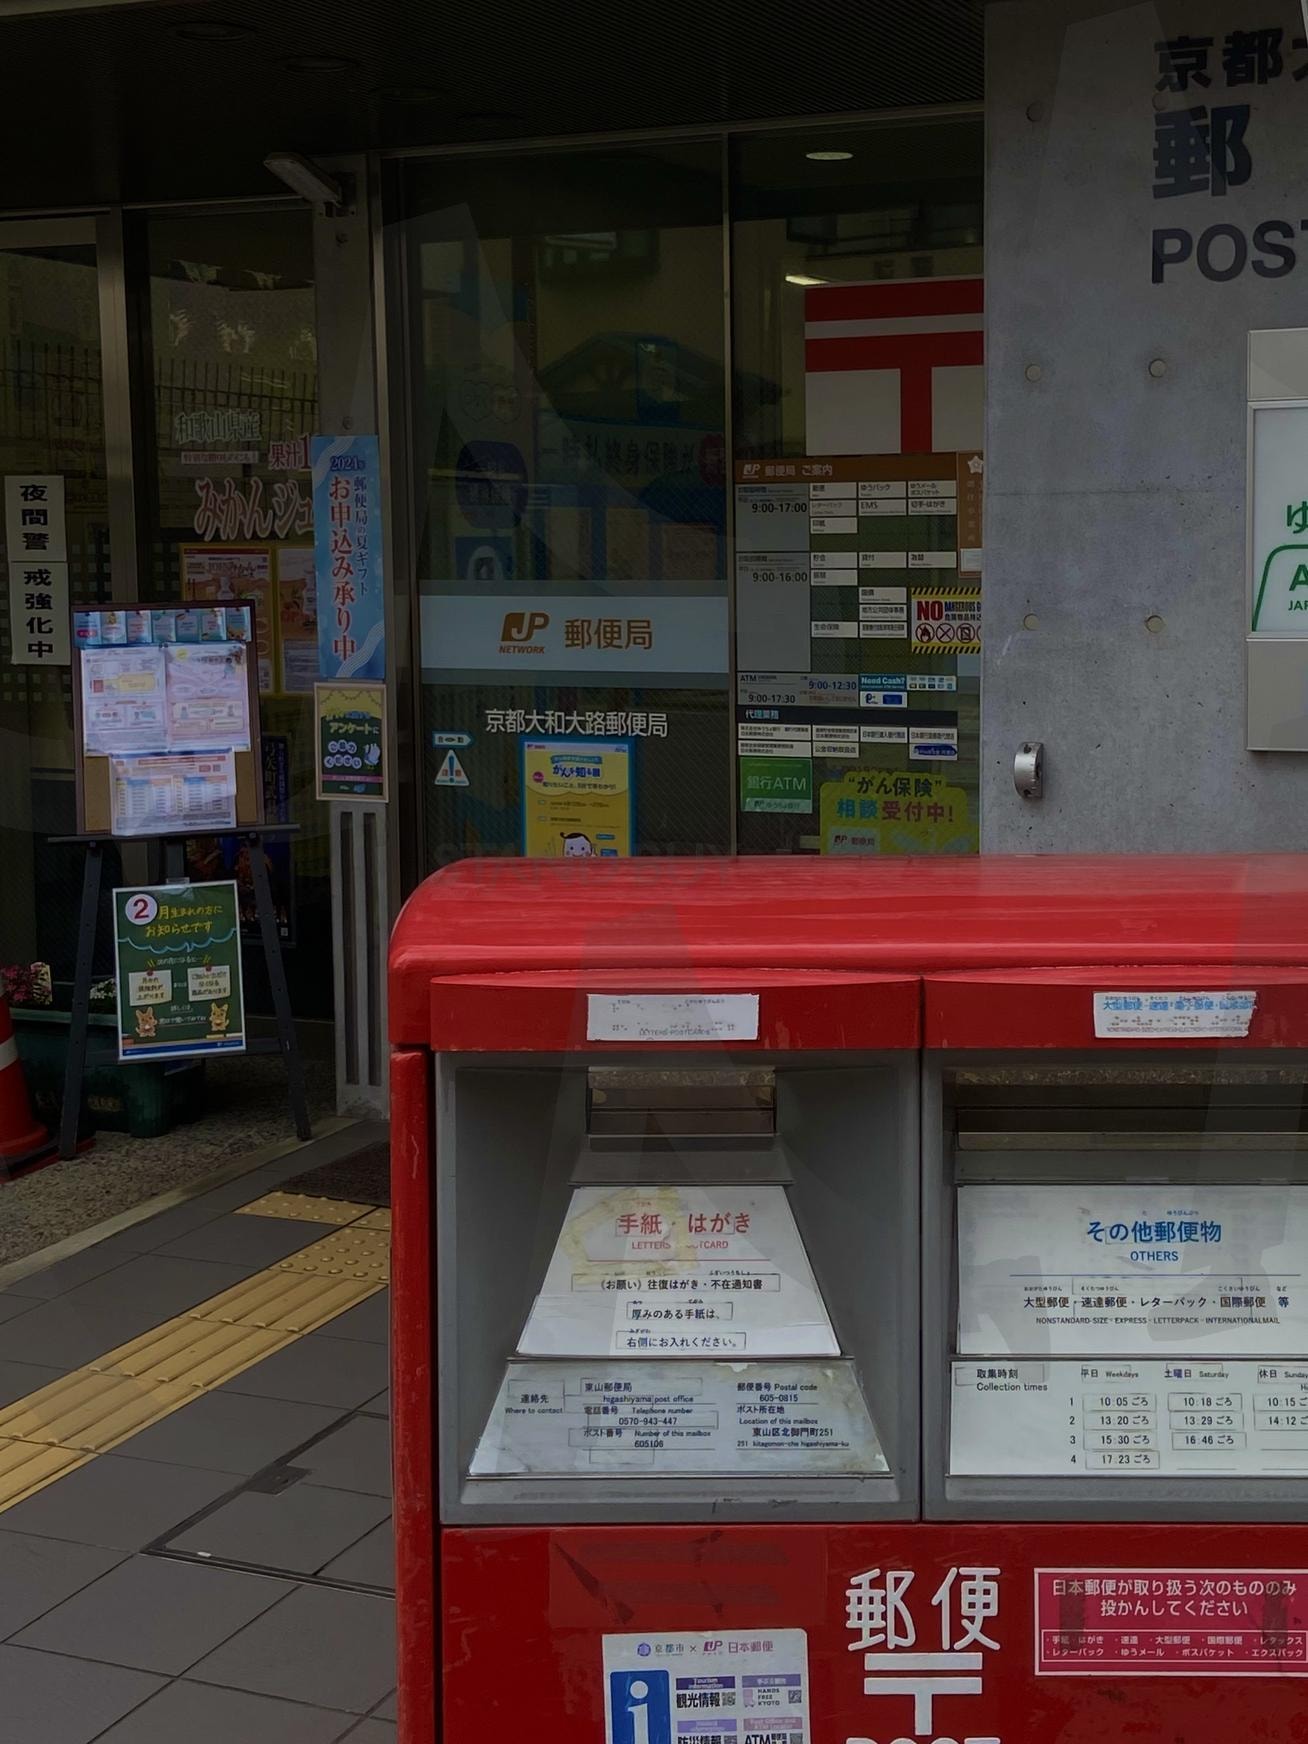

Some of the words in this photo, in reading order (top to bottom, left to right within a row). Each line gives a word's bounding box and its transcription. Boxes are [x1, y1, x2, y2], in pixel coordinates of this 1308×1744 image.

[1153, 105, 1252, 199] 郵
[1152, 220, 1308, 283] POS
[175, 411, 262, 444] 和歌山県産
[752, 503, 807, 513] 9:00-17:00
[860, 501, 878, 509] EMS
[353, 476, 369, 596] 郵便局の夏ギフト
[330, 476, 357, 661] お申込み承り中
[752, 572, 807, 582] 9:00-16:00
[916, 601, 943, 621] NO
[564, 619, 653, 651] 郵便局
[498, 645, 546, 655] NETWORK
[808, 681, 857, 690] 9:00-12:30
[861, 677, 884, 685] Need
[885, 677, 906, 686] Cash?
[748, 694, 796, 704] 9:00-17:30
[485, 708, 669, 738] 京都大和大路郵便局
[746, 776, 807, 791] 銀行ATM
[134, 899, 149, 919] 2
[145, 921, 213, 937] お知らせです
[1087, 1220, 1222, 1243] その他郵便物
[631, 1241, 671, 1249] LETTERS
[1130, 1251, 1179, 1261] OTHERS
[632, 1308, 720, 1320] 厚みのある手紙は、
[627, 1337, 737, 1348] 右側にお入れください。
[976, 1368, 1018, 1379] 取集時刻
[1081, 1368, 1099, 1379] 平日
[1105, 1370, 1139, 1379] Weekdays
[1164, 1368, 1192, 1379] 土曜日
[1199, 1370, 1229, 1380] Saturday
[1259, 1369, 1277, 1378] 休日
[585, 1382, 632, 1393] 東山郵便局
[737, 1382, 771, 1391] 郵便番号
[774, 1383, 798, 1391] Postal
[800, 1383, 818, 1391] code
[976, 1382, 1021, 1391] Collection
[1024, 1382, 1048, 1391] times
[520, 1394, 549, 1404] 連絡先
[603, 1395, 652, 1404] higashiyama
[654, 1395, 670, 1404] post
[672, 1395, 693, 1403] office
[759, 1394, 798, 1402] 605-0815
[584, 1406, 618, 1415] 電話番号
[632, 1407, 665, 1415] Telephone
[737, 1405, 785, 1414] ポスト所在地
[618, 1417, 677, 1426] 0570-943-447
[1069, 1416, 1075, 1425] 2
[584, 1429, 622, 1438] ポスト番号
[1069, 1435, 1075, 1444] 3
[1070, 1454, 1076, 1464] 4
[1053, 1579, 1297, 1597] 日本郵便が取り扱う次のもののみ
[845, 1567, 1001, 1652] 郵便
[1100, 1600, 1249, 1617] 投かんしてください
[728, 1640, 773, 1653] 日本郵便
[1052, 1648, 1104, 1657] レターパック
[1121, 1648, 1165, 1657] ゆうメール
[1182, 1648, 1234, 1657] ポスパケット
[1251, 1648, 1303, 1657] エクスパック
[676, 1692, 720, 1708] 観光情報
